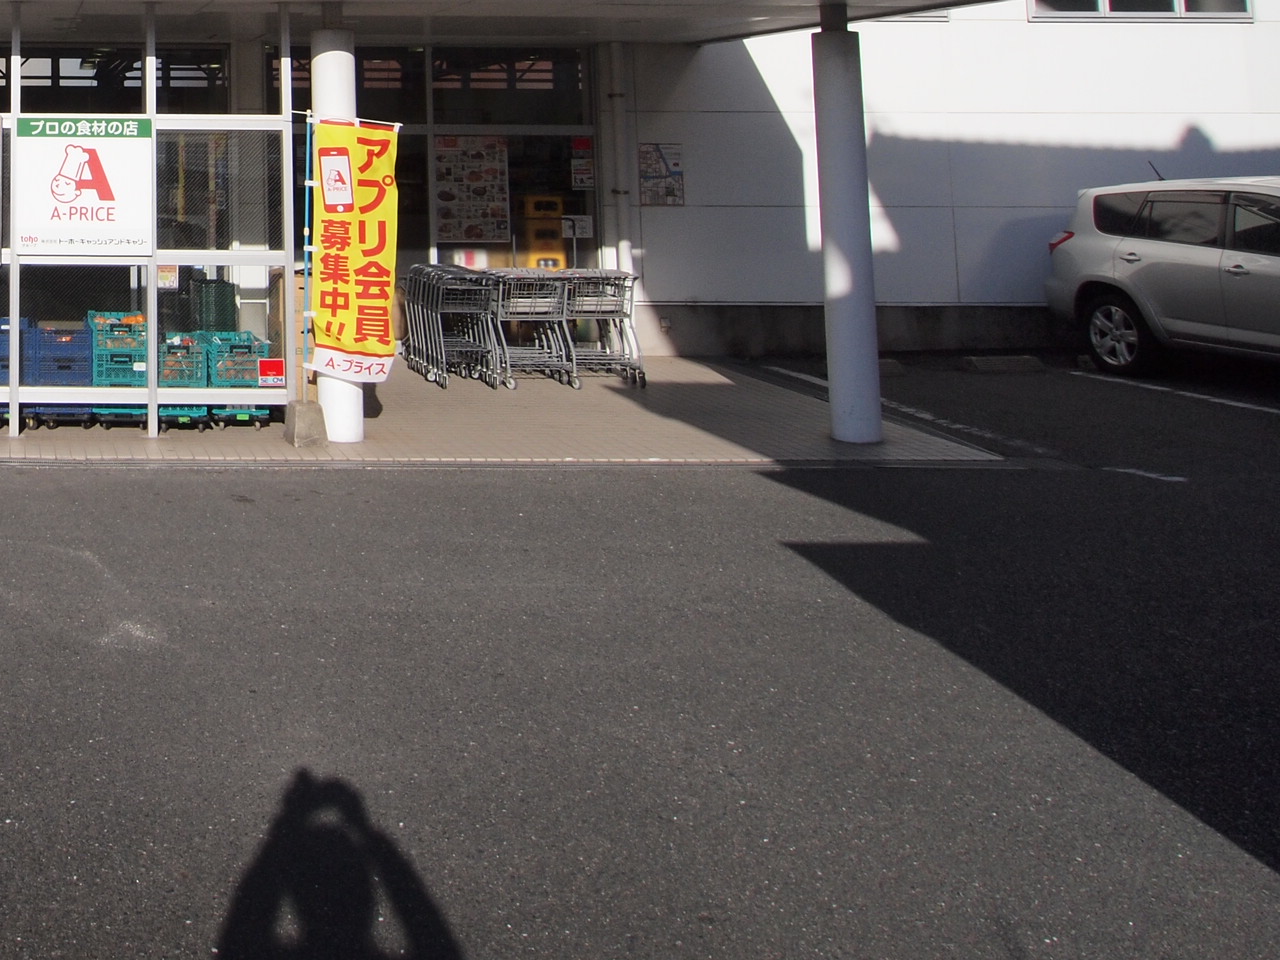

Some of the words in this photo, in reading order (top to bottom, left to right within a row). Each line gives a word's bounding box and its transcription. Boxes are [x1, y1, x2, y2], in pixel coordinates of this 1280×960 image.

[30, 120, 138, 136] プロの食材の店
[50, 206, 116, 221] A-PRICE
[353, 136, 395, 346] アプリ会員
[324, 356, 387, 377] A-プライス
